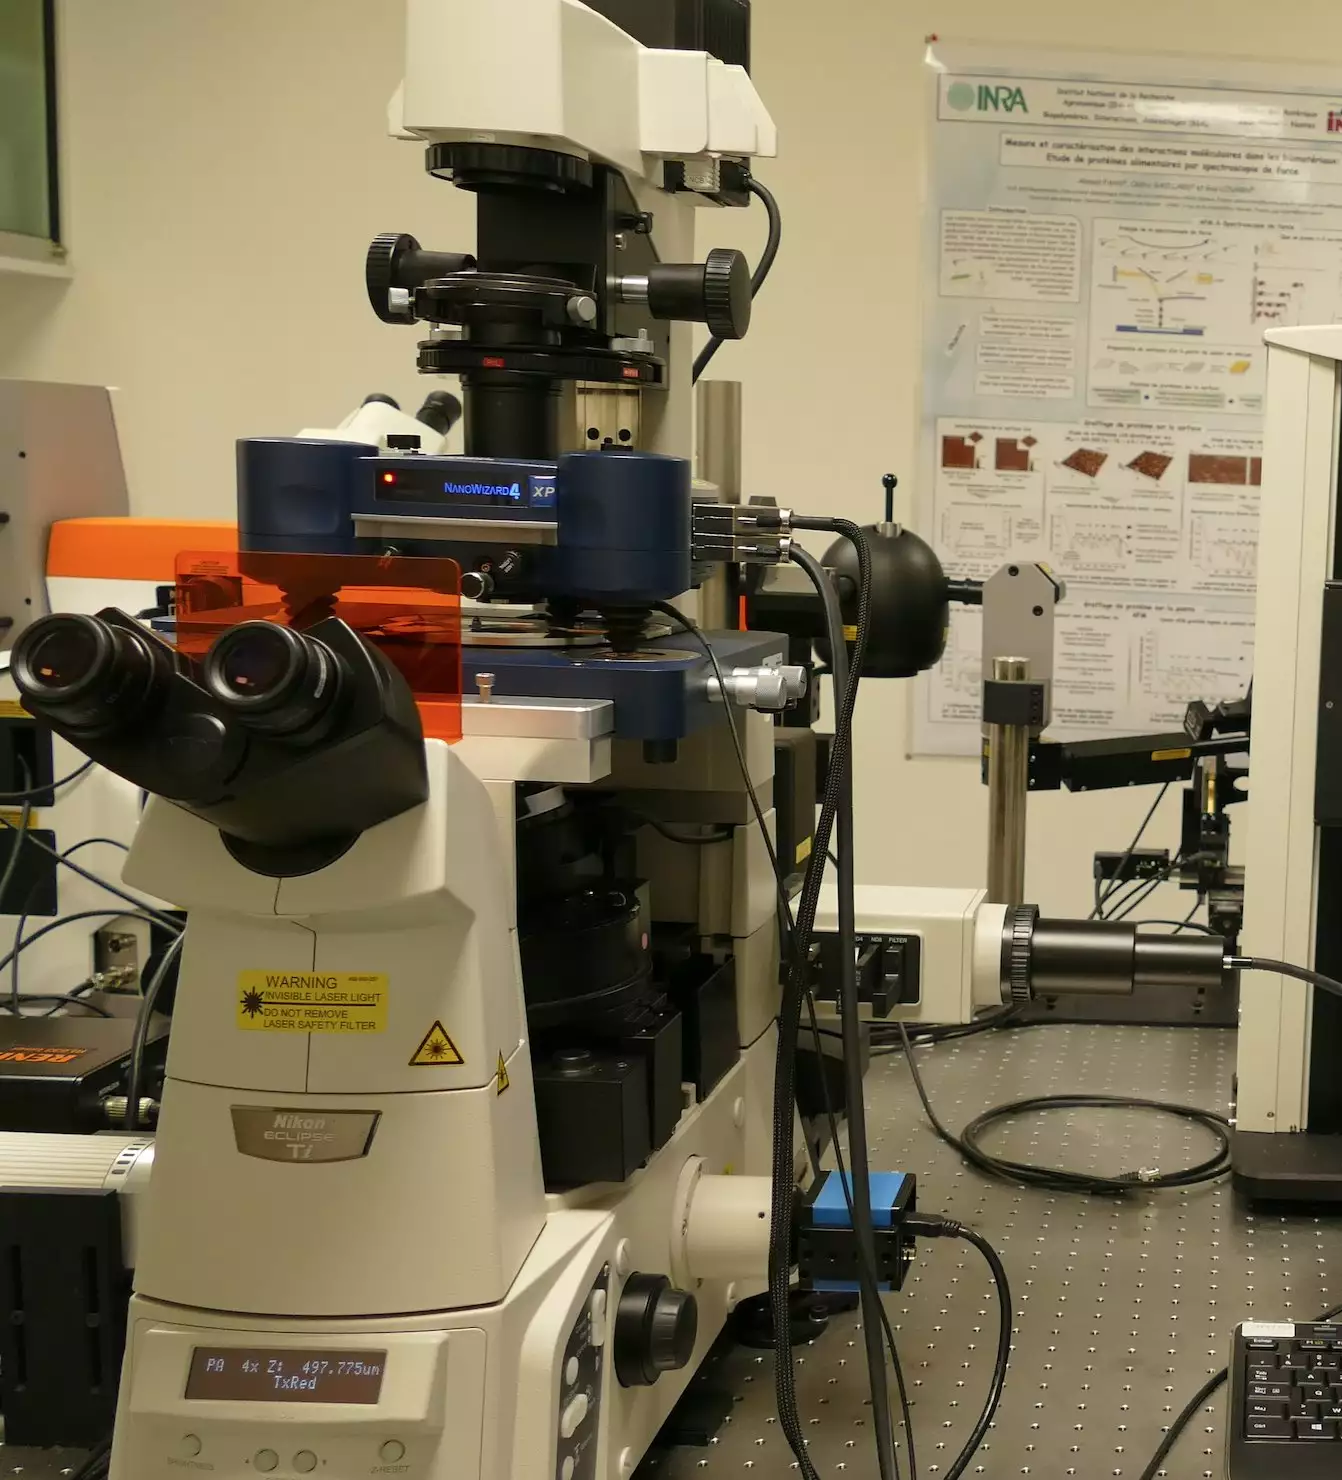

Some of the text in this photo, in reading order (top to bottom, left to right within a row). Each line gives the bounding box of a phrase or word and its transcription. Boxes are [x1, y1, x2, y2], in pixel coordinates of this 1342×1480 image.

[977, 84, 1029, 113] INRA
[1005, 138, 1036, 148] Mesure
[1039, 140, 1049, 148] et
[1052, 141, 1116, 152] caractérisation
[1119, 144, 1134, 153] des
[1138, 145, 1187, 156] interactions
[1046, 153, 1070, 163] Etude
[1074, 155, 1085, 163] de
[1087, 157, 1127, 168] protéines
[1130, 159, 1181, 169] alimentaires
[1184, 163, 1199, 172] par
[1262, 166, 1273, 174] de
[532, 486, 556, 498] XP
[266, 975, 337, 989] WARNING
[265, 991, 382, 1002] INVISIBLE LASER LIGHT
[264, 1008, 348, 1018] DO NOT REMOVE
[264, 1019, 376, 1030] LASER SAFETY FILTER
[273, 1114, 326, 1129] Nikon
[286, 1144, 314, 1159] Ti
[206, 1358, 380, 1376] PA 4x Z: 497.775um
[274, 1375, 317, 1390] TxRed
